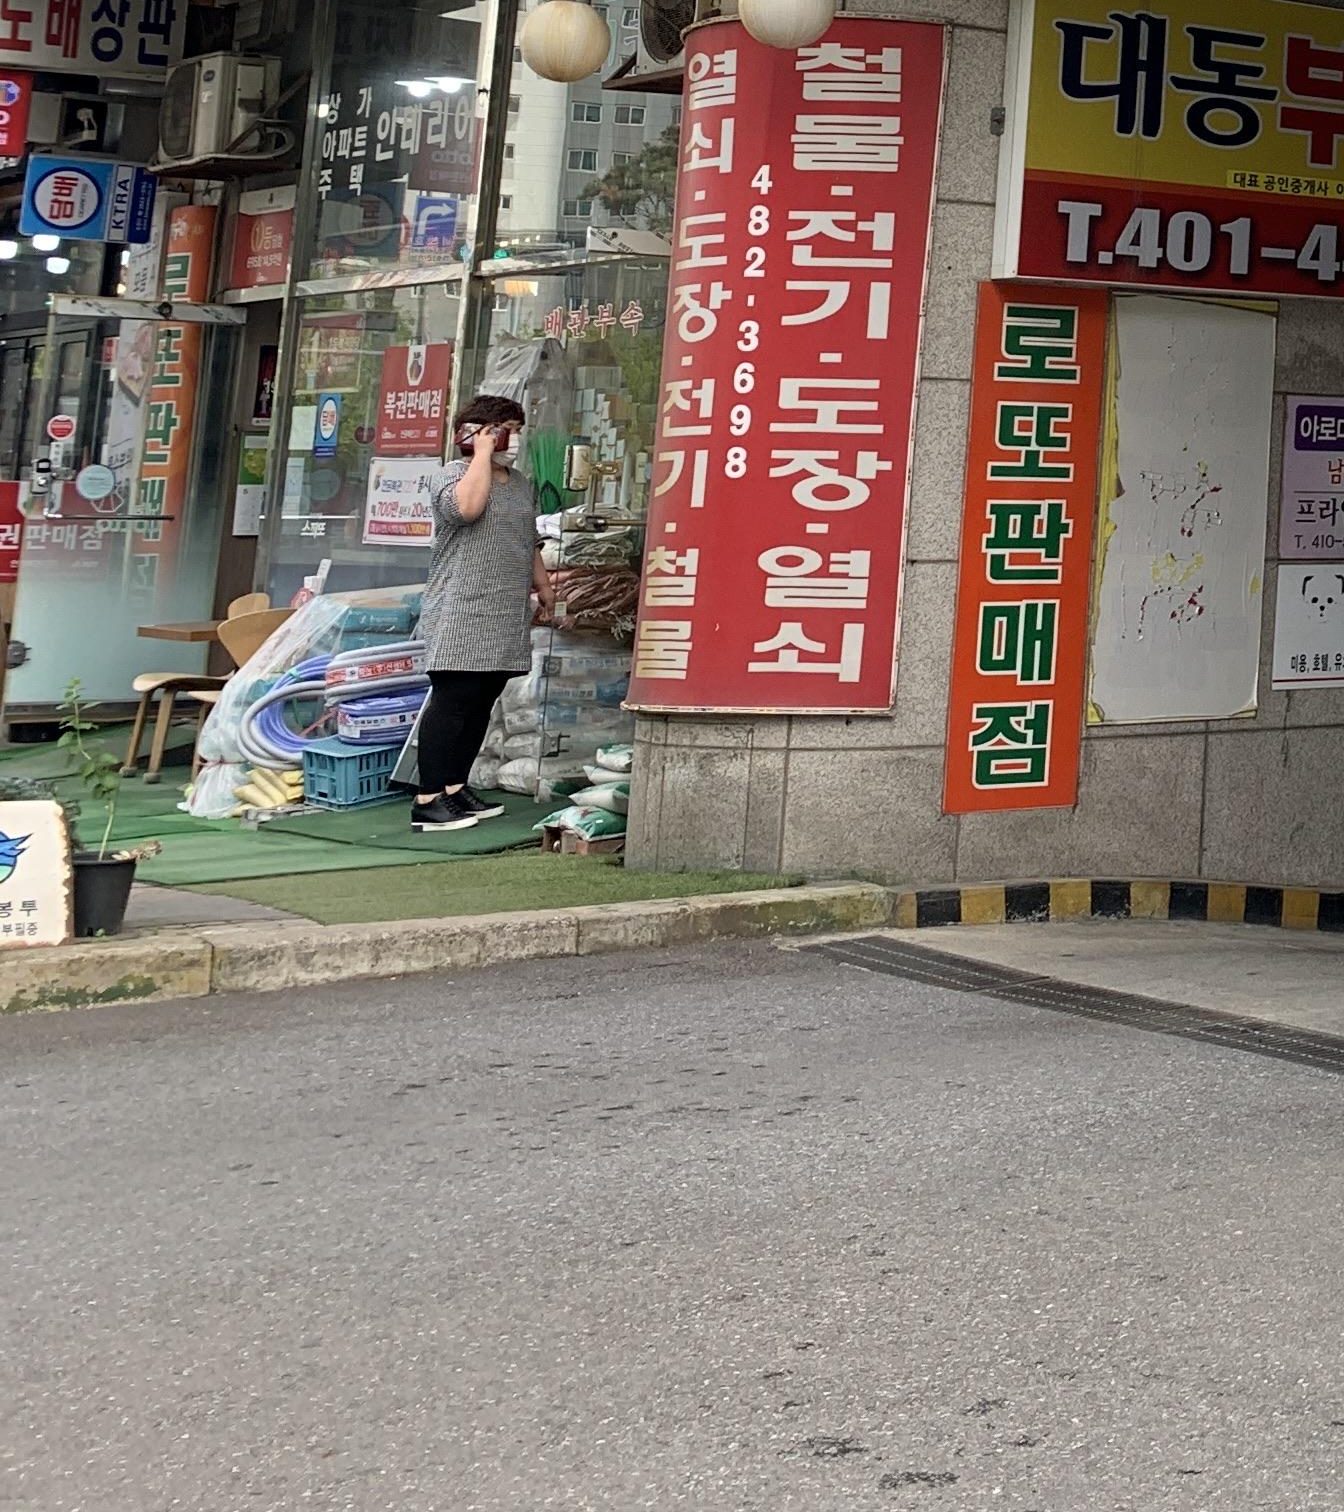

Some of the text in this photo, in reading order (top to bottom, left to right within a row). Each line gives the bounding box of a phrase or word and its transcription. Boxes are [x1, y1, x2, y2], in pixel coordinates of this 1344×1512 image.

[1232, 171, 1261, 189] 대표
[1263, 174, 1330, 197] 공인중개사
[111, 177, 131, 230] KTRA
[543, 300, 645, 340] 배관부속
[383, 388, 443, 420] 복권판매점
[967, 301, 1082, 792] 로또판매점
[1294, 534, 1308, 550] T.
